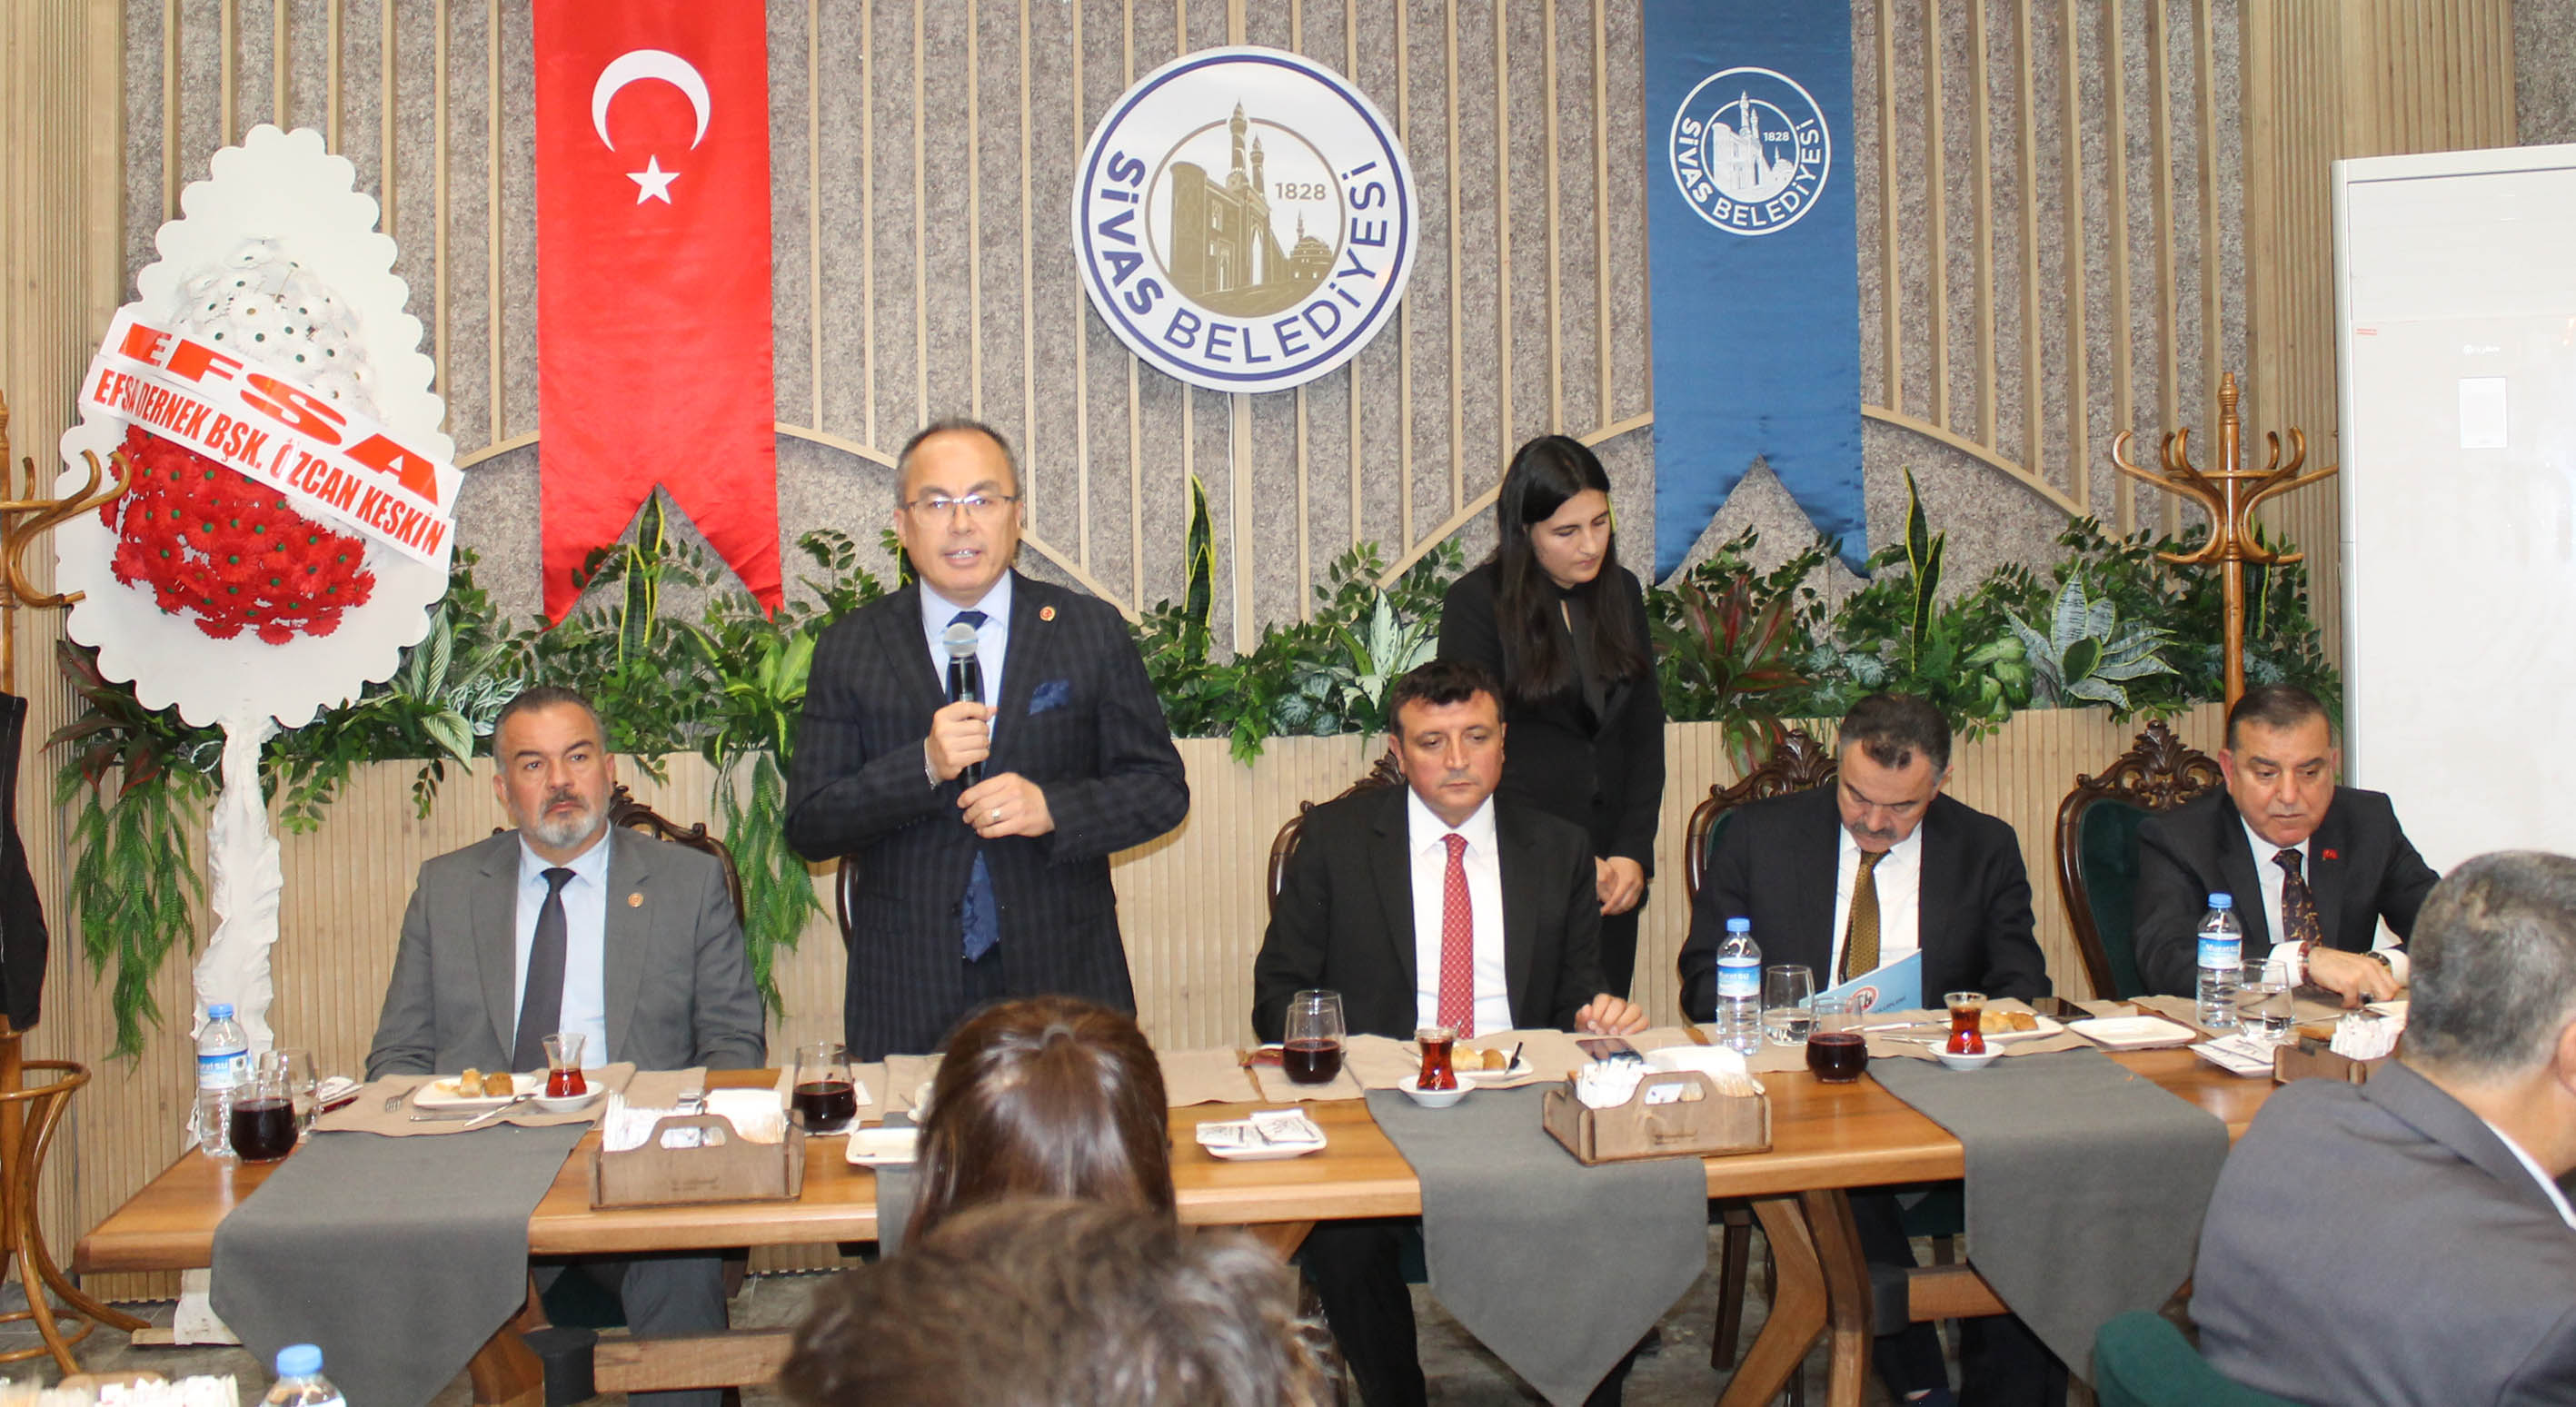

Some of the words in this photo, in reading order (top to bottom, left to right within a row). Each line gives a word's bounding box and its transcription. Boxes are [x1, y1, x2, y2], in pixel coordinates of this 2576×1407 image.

[1763, 131, 1790, 142] 1828
[1274, 182, 1327, 201] 1828
[94, 368, 141, 414] EFSA
[136, 381, 214, 441] DERNEK
[203, 412, 270, 471] BŞK.
[355, 485, 446, 557] KESKİN
[118, 322, 438, 507] EFSA
